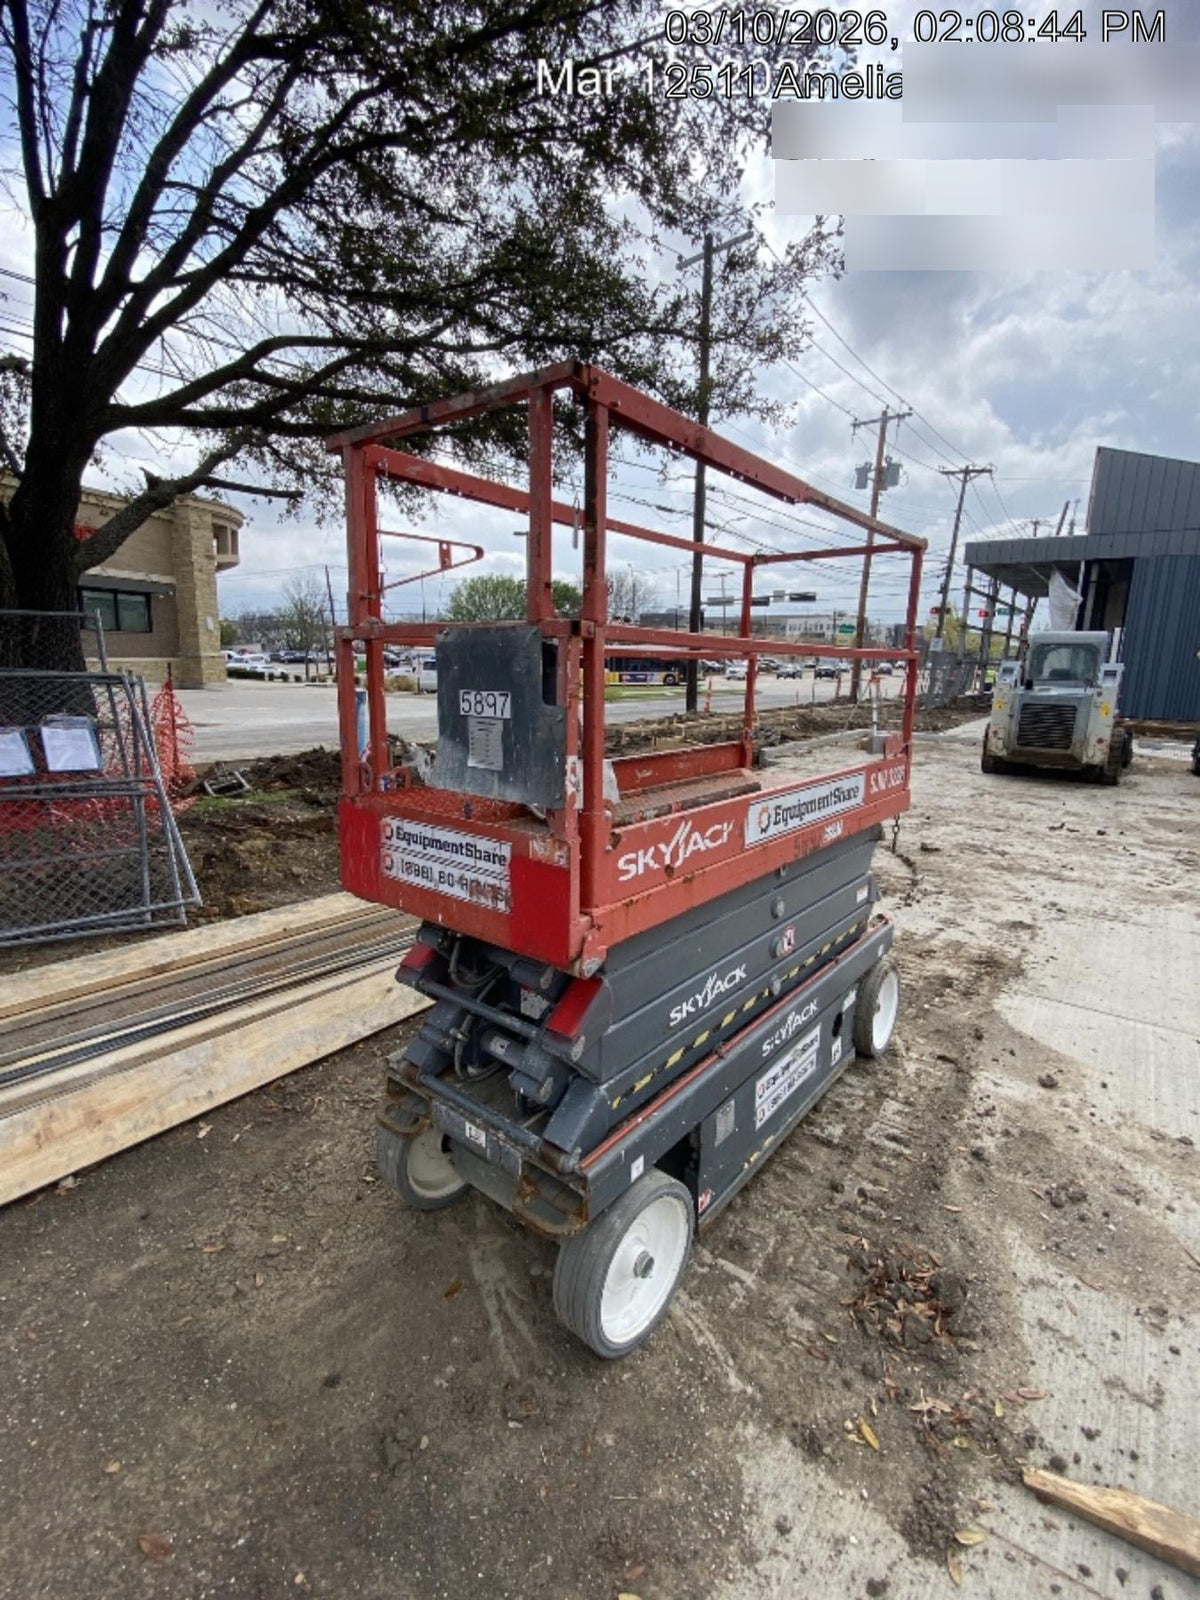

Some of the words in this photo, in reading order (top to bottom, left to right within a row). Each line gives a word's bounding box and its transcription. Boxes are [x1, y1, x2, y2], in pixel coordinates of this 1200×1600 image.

[461, 690, 509, 717] 5897
[772, 784, 860, 828] EquipmentShare
[395, 825, 508, 868] EquipmentShare
[669, 963, 747, 1027] SKYJACK
